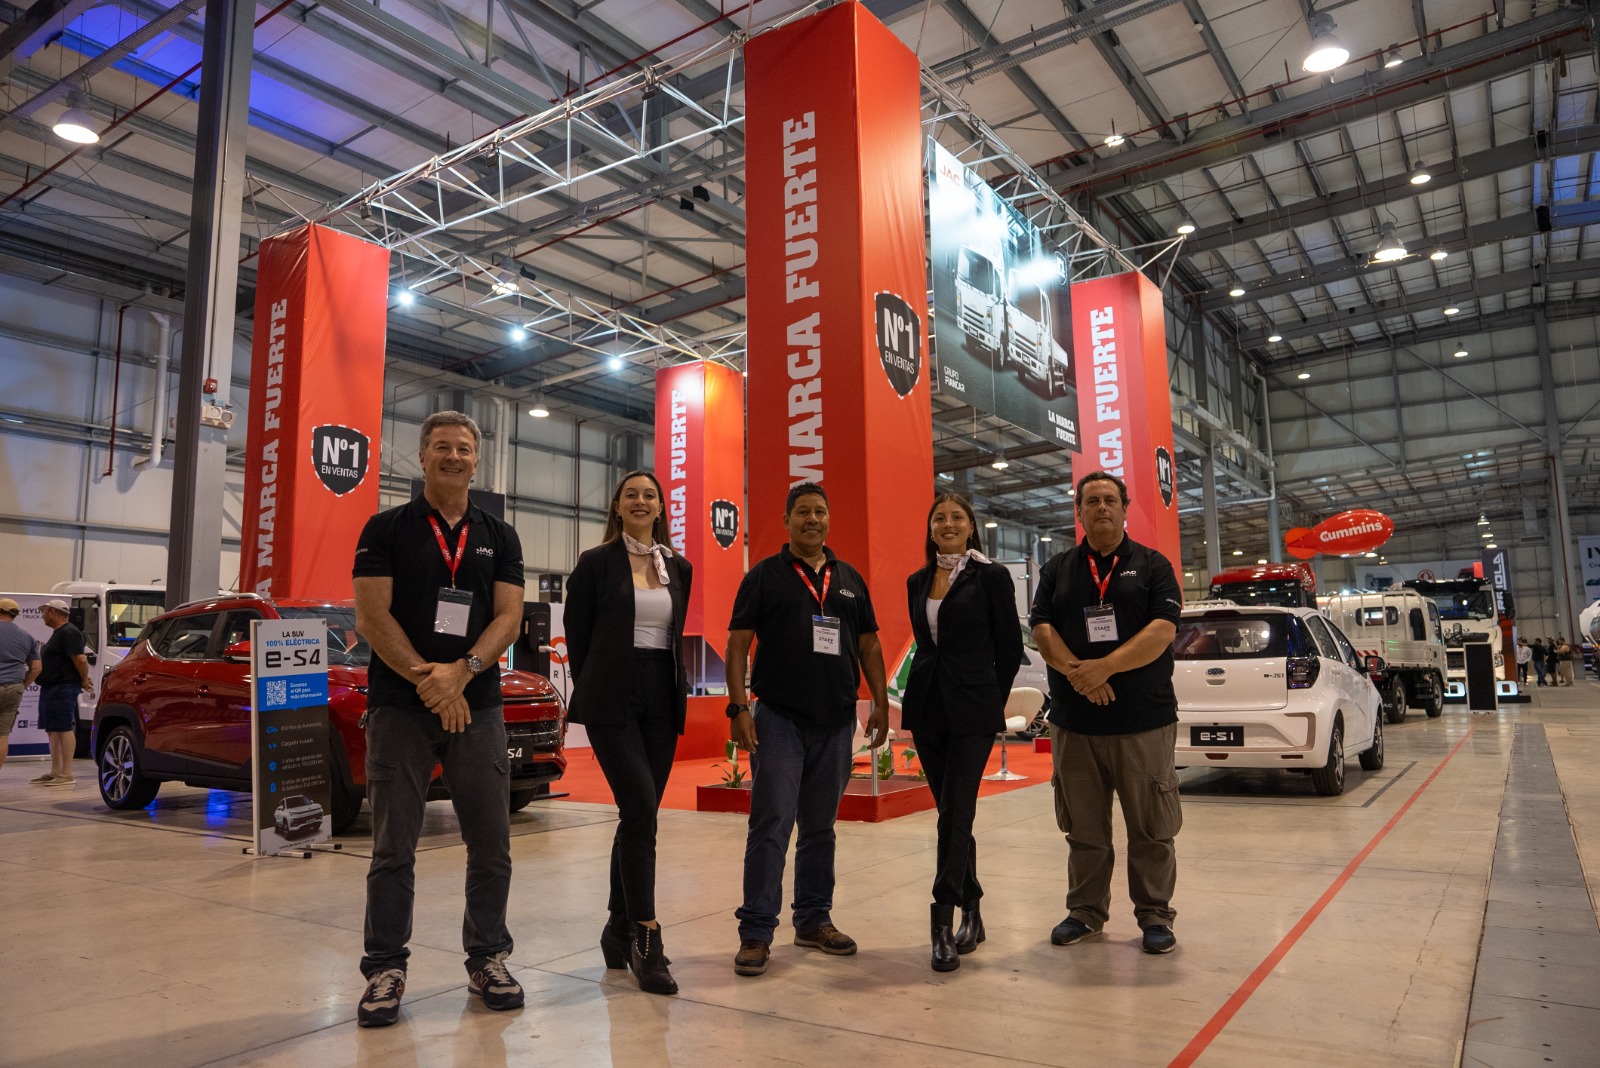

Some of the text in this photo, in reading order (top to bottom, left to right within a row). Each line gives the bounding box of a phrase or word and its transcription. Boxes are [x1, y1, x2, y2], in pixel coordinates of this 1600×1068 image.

[940, 165, 960, 186] JAC
[783, 111, 820, 303] FUERTE
[884, 307, 914, 360] Nº1
[264, 298, 287, 432] FUERTE
[884, 350, 915, 375] EN VENTAS
[944, 366, 959, 380] GRUPO
[1090, 306, 1120, 422] FUERTE
[1048, 410, 1075, 432] LA MARCA
[671, 389, 687, 480] FUERTE
[1056, 428, 1076, 445] FUERTE
[322, 436, 360, 468] Nº1
[321, 465, 358, 478] EN VENTAS
[258, 438, 279, 567] MARCA
[715, 507, 734, 530] Nº1
[1320, 522, 1383, 542] Cummins
[286, 638, 320, 646] ELÉCTRICA
